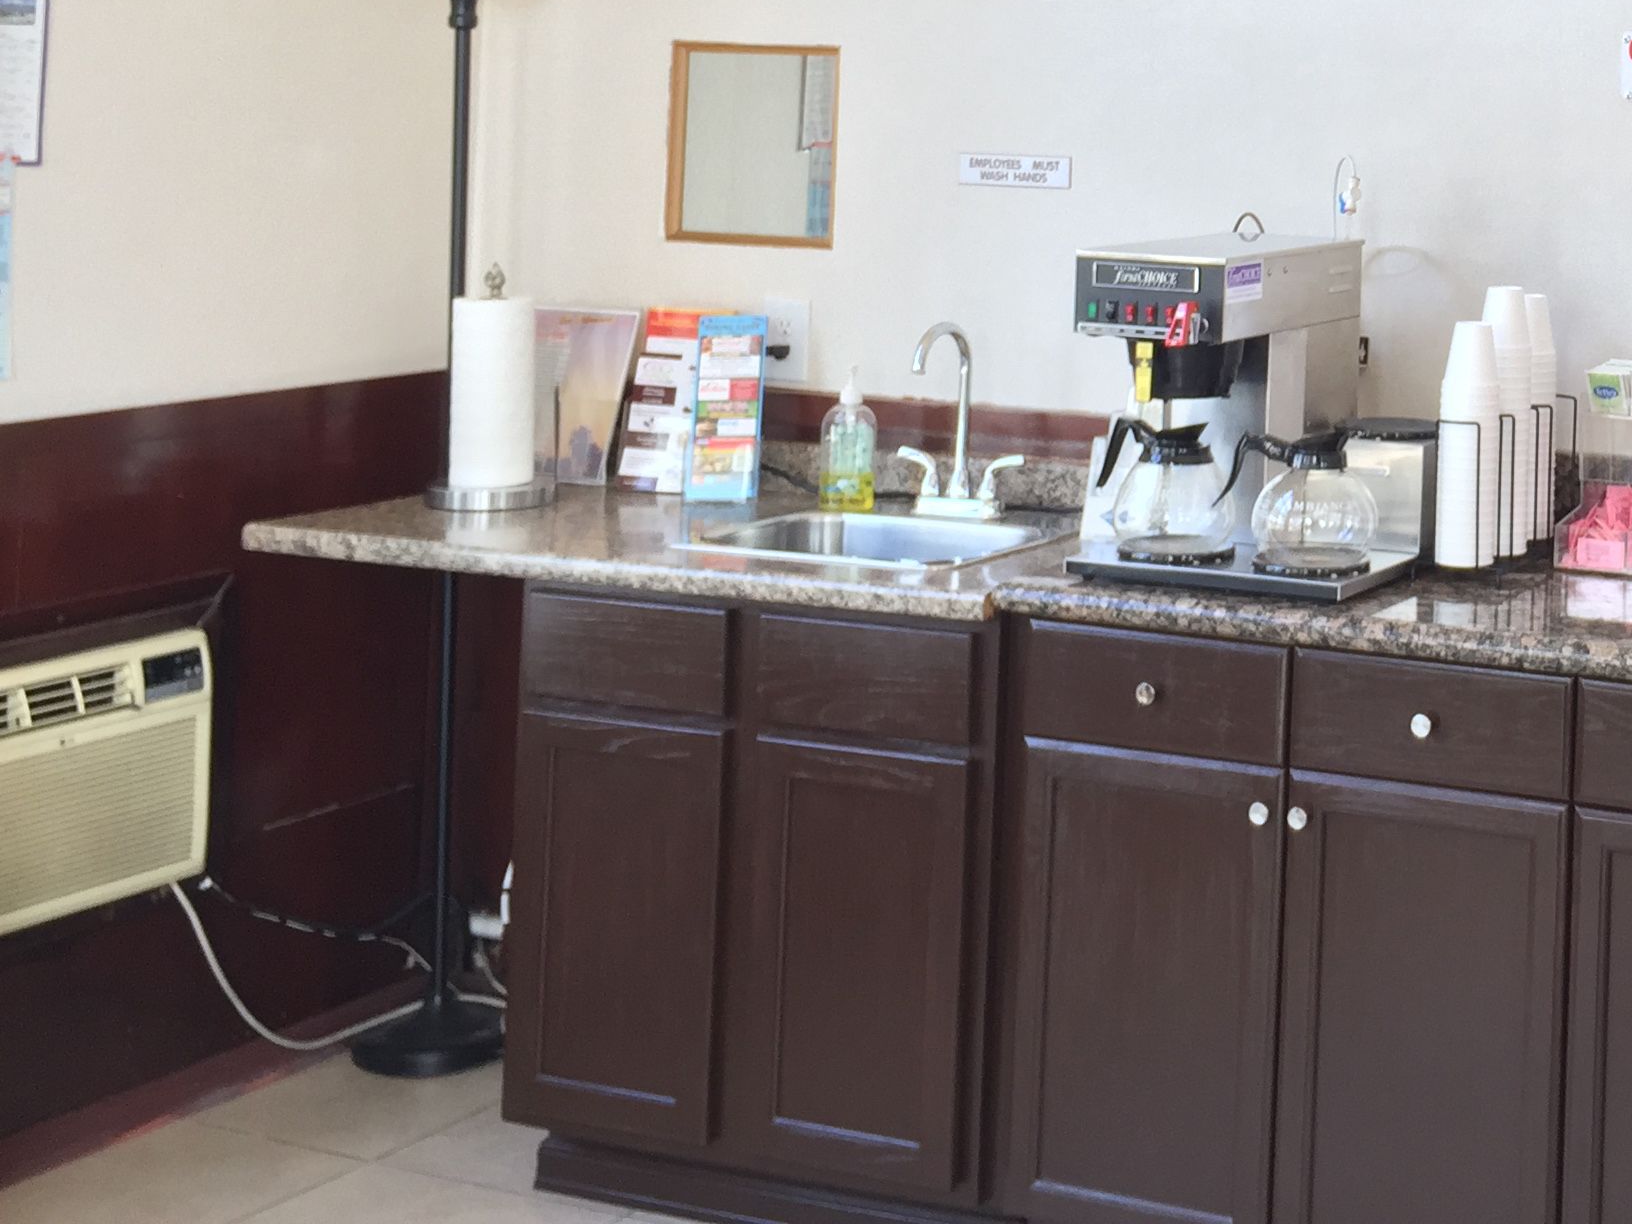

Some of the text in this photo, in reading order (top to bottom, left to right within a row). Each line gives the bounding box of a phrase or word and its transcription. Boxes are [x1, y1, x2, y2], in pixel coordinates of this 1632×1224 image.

[969, 157, 1061, 172] EMPLOYEES MUST
[980, 170, 1048, 183] WASH HANDS
